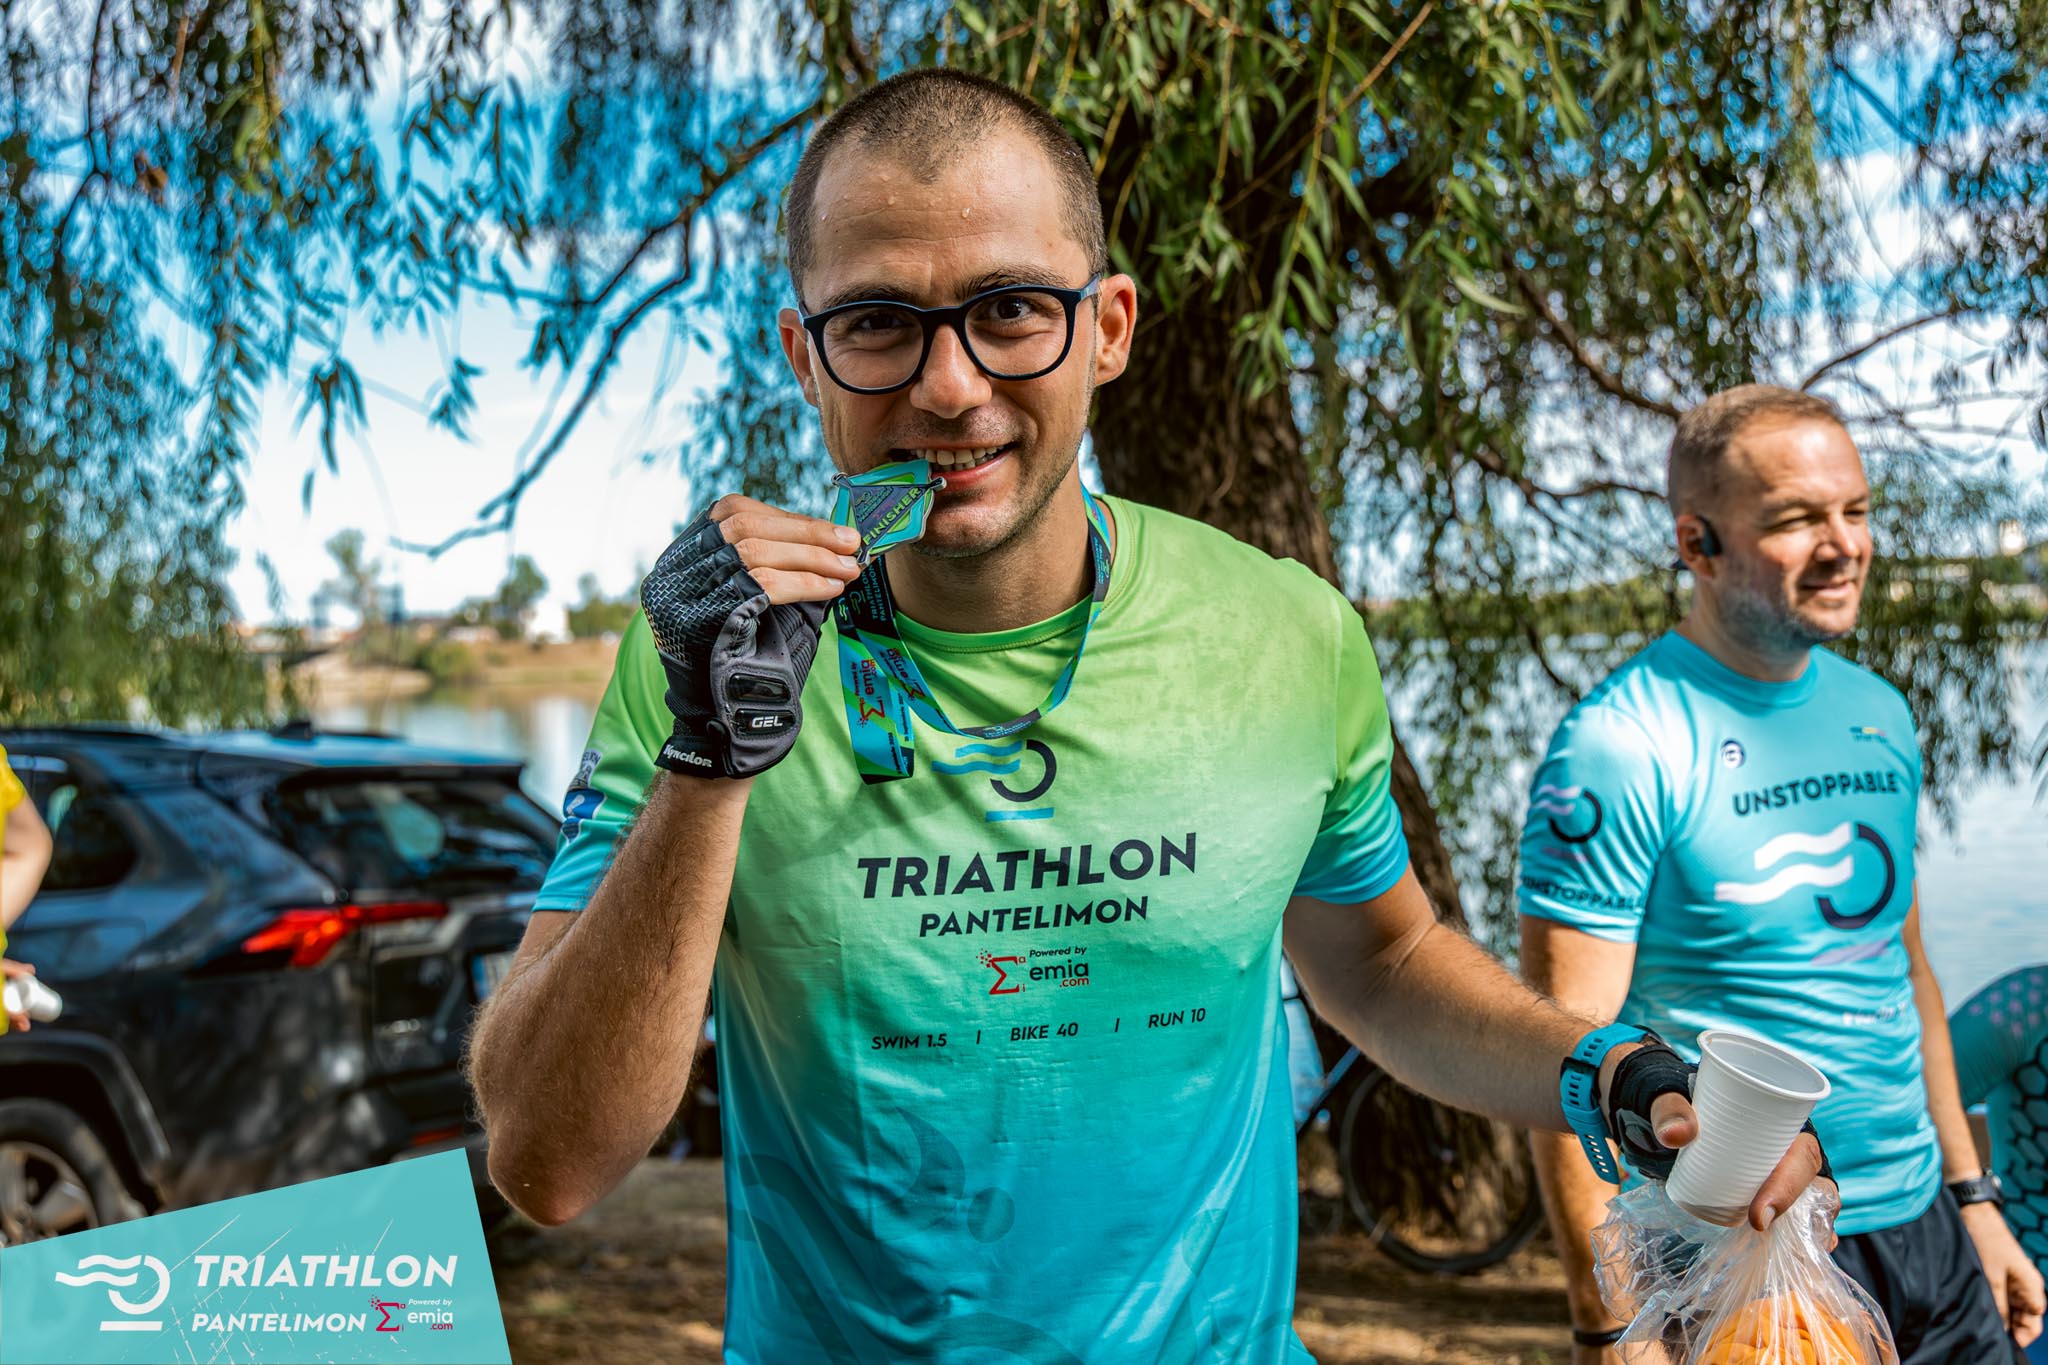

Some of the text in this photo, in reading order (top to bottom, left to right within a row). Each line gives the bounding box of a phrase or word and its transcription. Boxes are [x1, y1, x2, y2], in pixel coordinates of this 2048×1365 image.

[862, 487, 922, 546] FINISHER
[862, 571, 878, 620] TRIATHLON
[869, 564, 887, 621] PANTELIMON
[752, 716, 783, 728] GEL
[1732, 771, 1899, 816] UNSTOPPABLE
[857, 832, 1197, 898] TRIATHLON
[918, 895, 1149, 938] PANTELIMON
[1029, 946, 1087, 958] Powered by
[1029, 959, 1089, 981] emia
[1059, 977, 1089, 987] .com
[871, 1034, 920, 1050] SWIM
[926, 1033, 947, 1048] 1.5
[1010, 1024, 1049, 1042] BIKE
[1056, 1022, 1079, 1038] 40
[1148, 1010, 1184, 1028] RUN
[1190, 1008, 1206, 1023] 10
